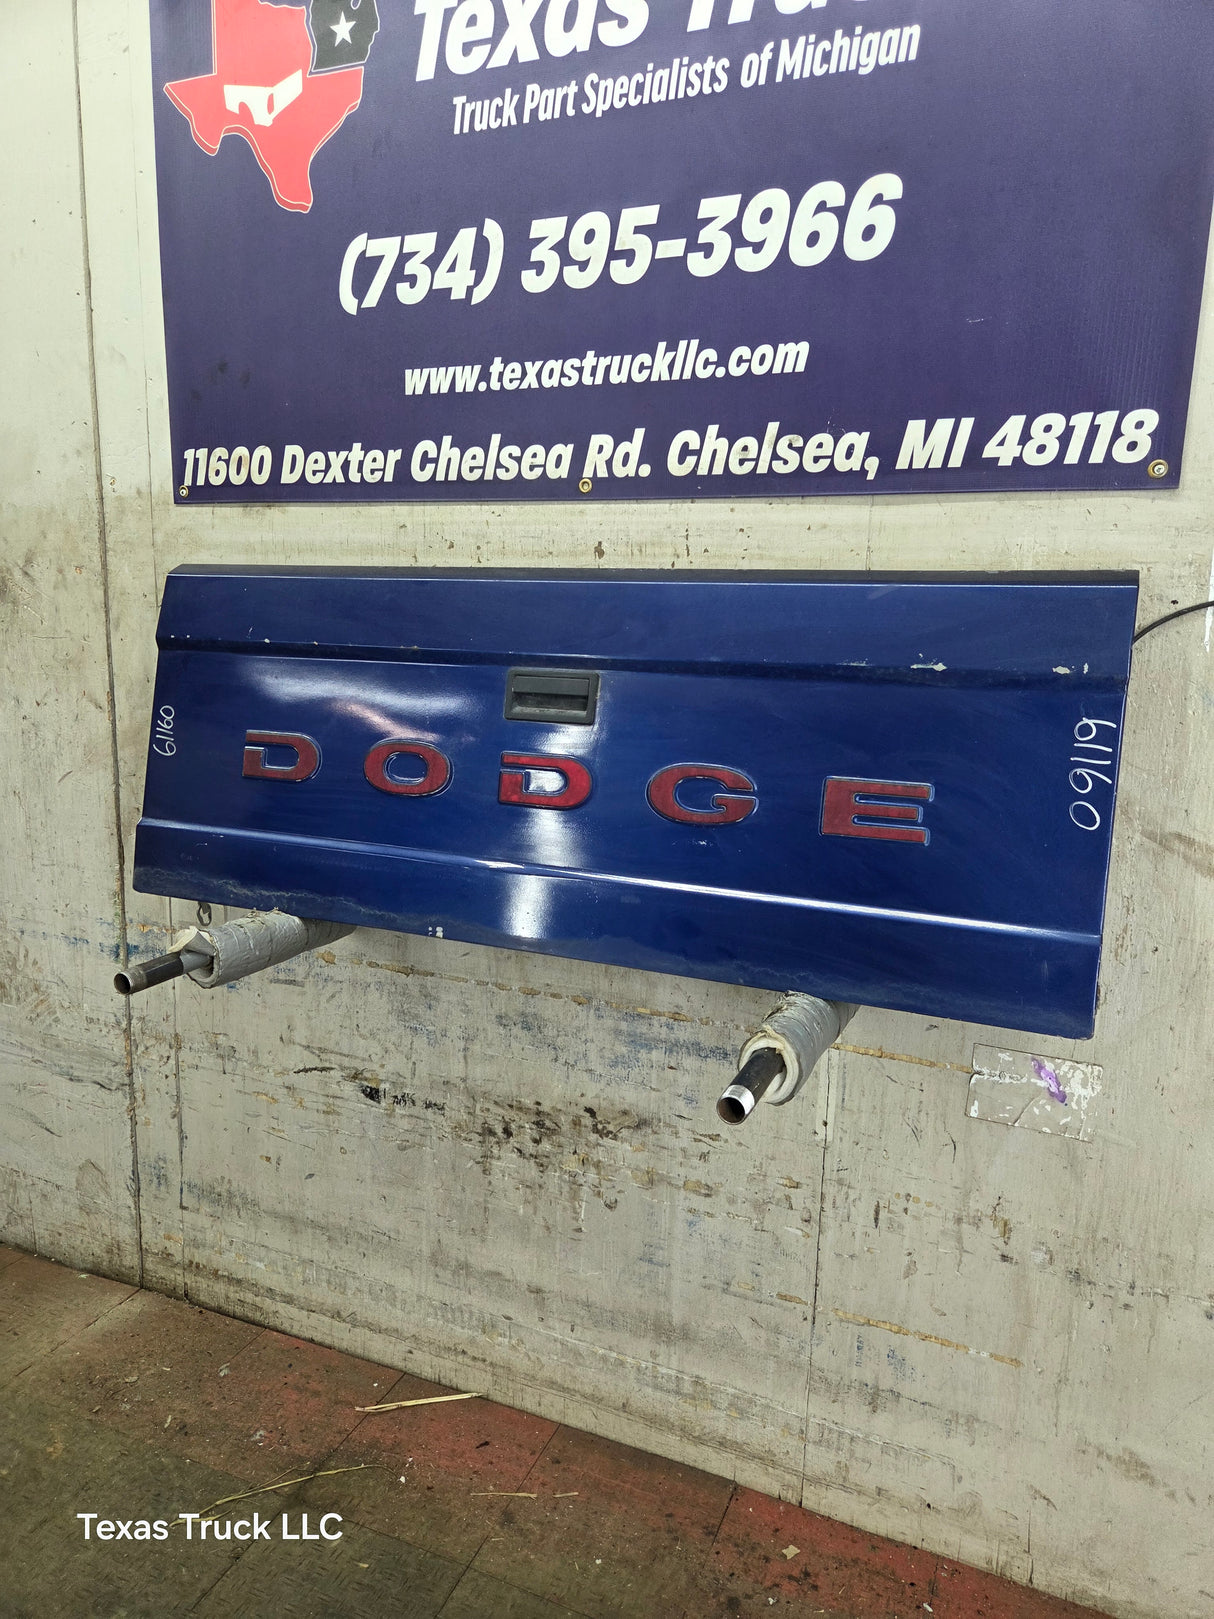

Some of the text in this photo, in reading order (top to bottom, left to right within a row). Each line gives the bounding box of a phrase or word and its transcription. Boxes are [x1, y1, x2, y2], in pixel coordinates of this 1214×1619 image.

[414, 0, 650, 82] Texas
[452, 24, 921, 135] Truck Part Specialists of Michigan
[339, 172, 904, 316] (734) 395-3966
[404, 339, 810, 396] www.texastruckllc.com
[182, 408, 1160, 488] 11600 Dexter Chelsea Rd. Chelsea, MI 48118
[152, 705, 177, 756] 61160
[1068, 716, 1118, 832] 61160
[241, 729, 935, 846] DODGE
